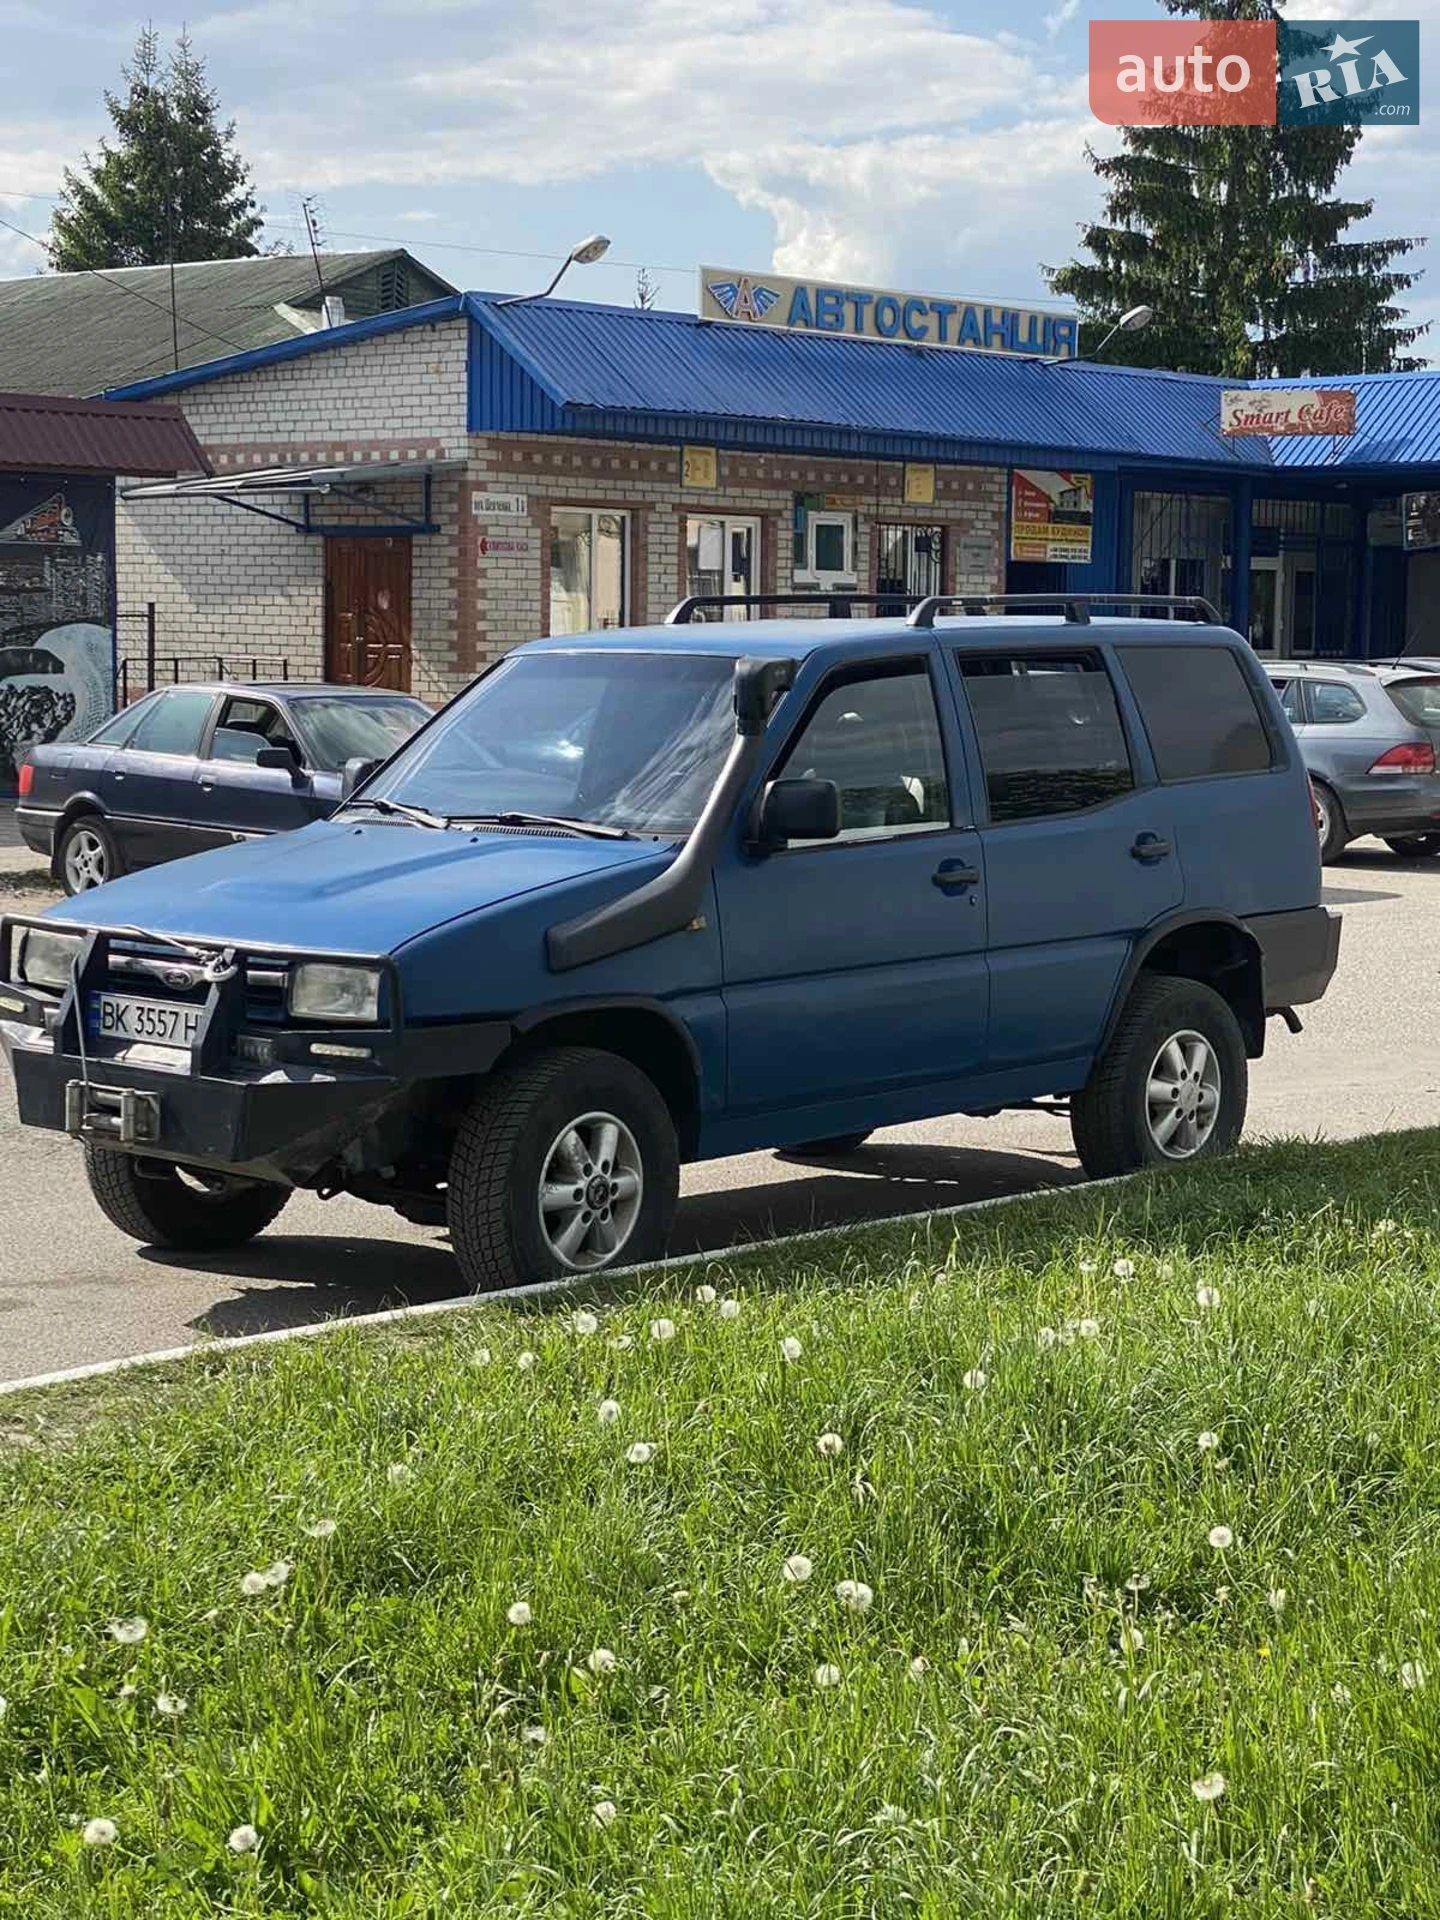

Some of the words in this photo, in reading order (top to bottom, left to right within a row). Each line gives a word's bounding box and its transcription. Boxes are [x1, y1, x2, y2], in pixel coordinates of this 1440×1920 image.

[787, 285, 1077, 357] АВТОСТАНЦІЯ
[1229, 408, 1291, 428] Smart
[102, 1001, 129, 1032] BK
[134, 1005, 180, 1039] 3557
[184, 1011, 199, 1041] H
